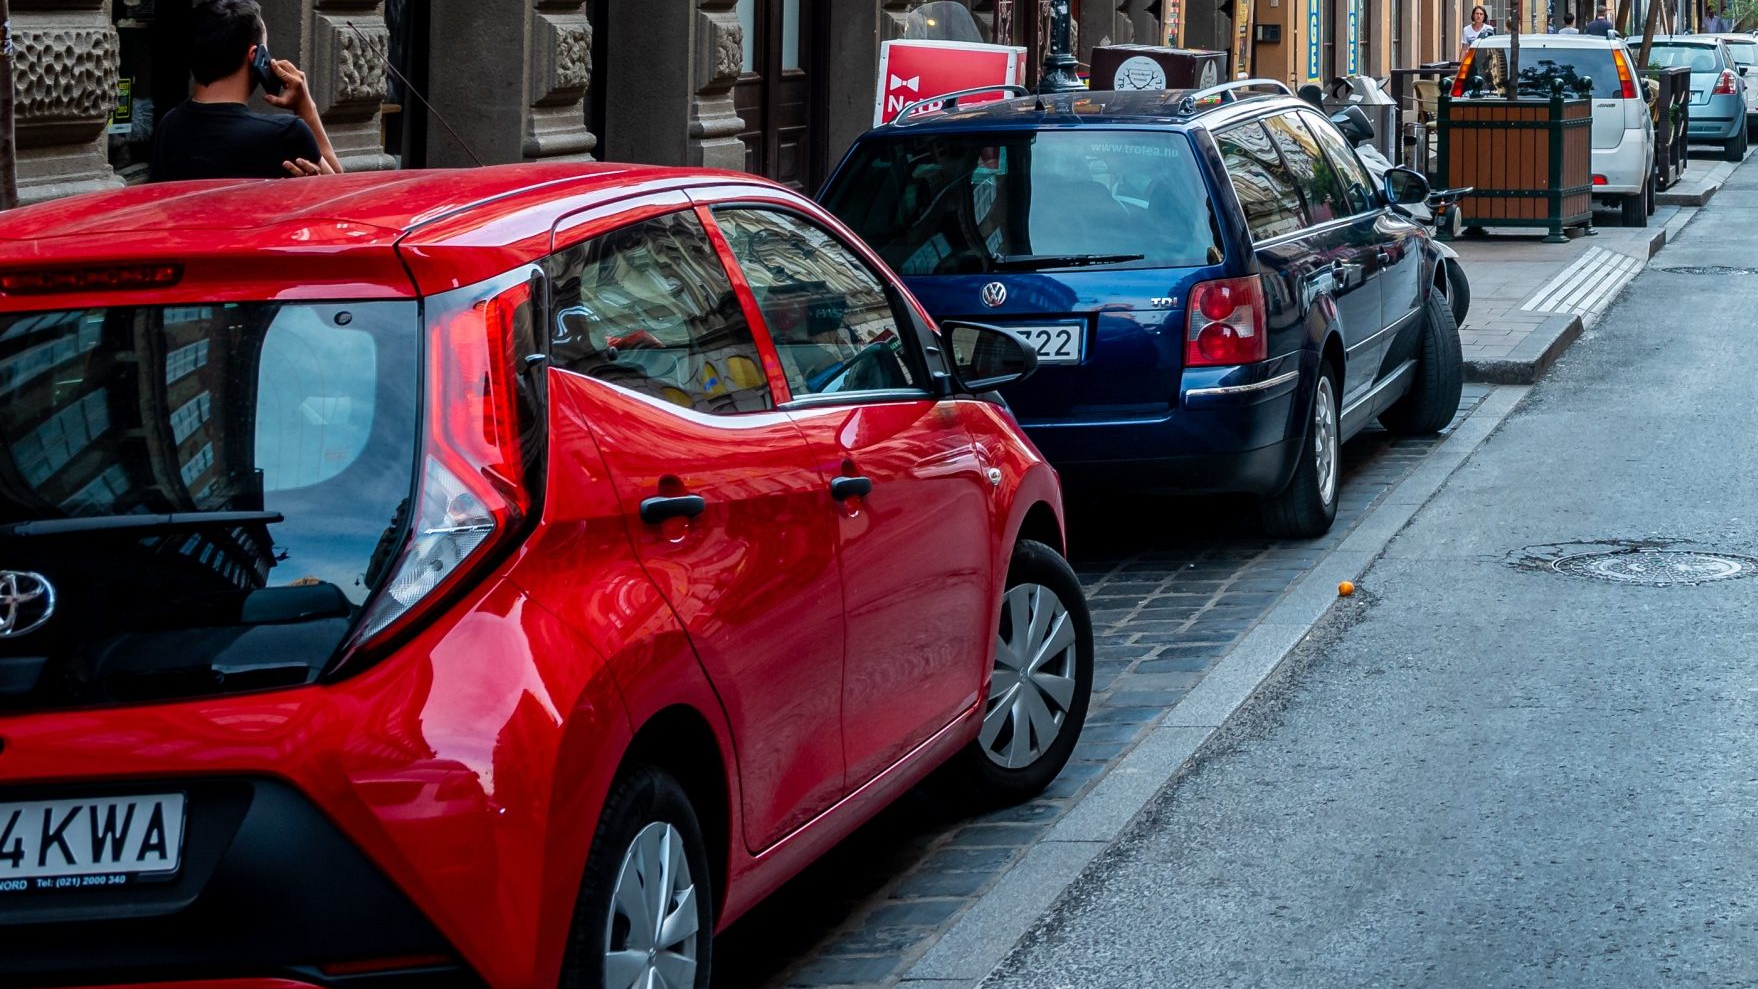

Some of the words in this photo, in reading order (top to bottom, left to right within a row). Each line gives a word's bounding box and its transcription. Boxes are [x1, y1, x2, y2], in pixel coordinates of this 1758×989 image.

[1151, 297, 1177, 307] TDI
[37, 878, 54, 888] Tel:
[56, 876, 81, 889] (021)
[83, 877, 106, 886] 2000
[108, 874, 126, 884] 340
